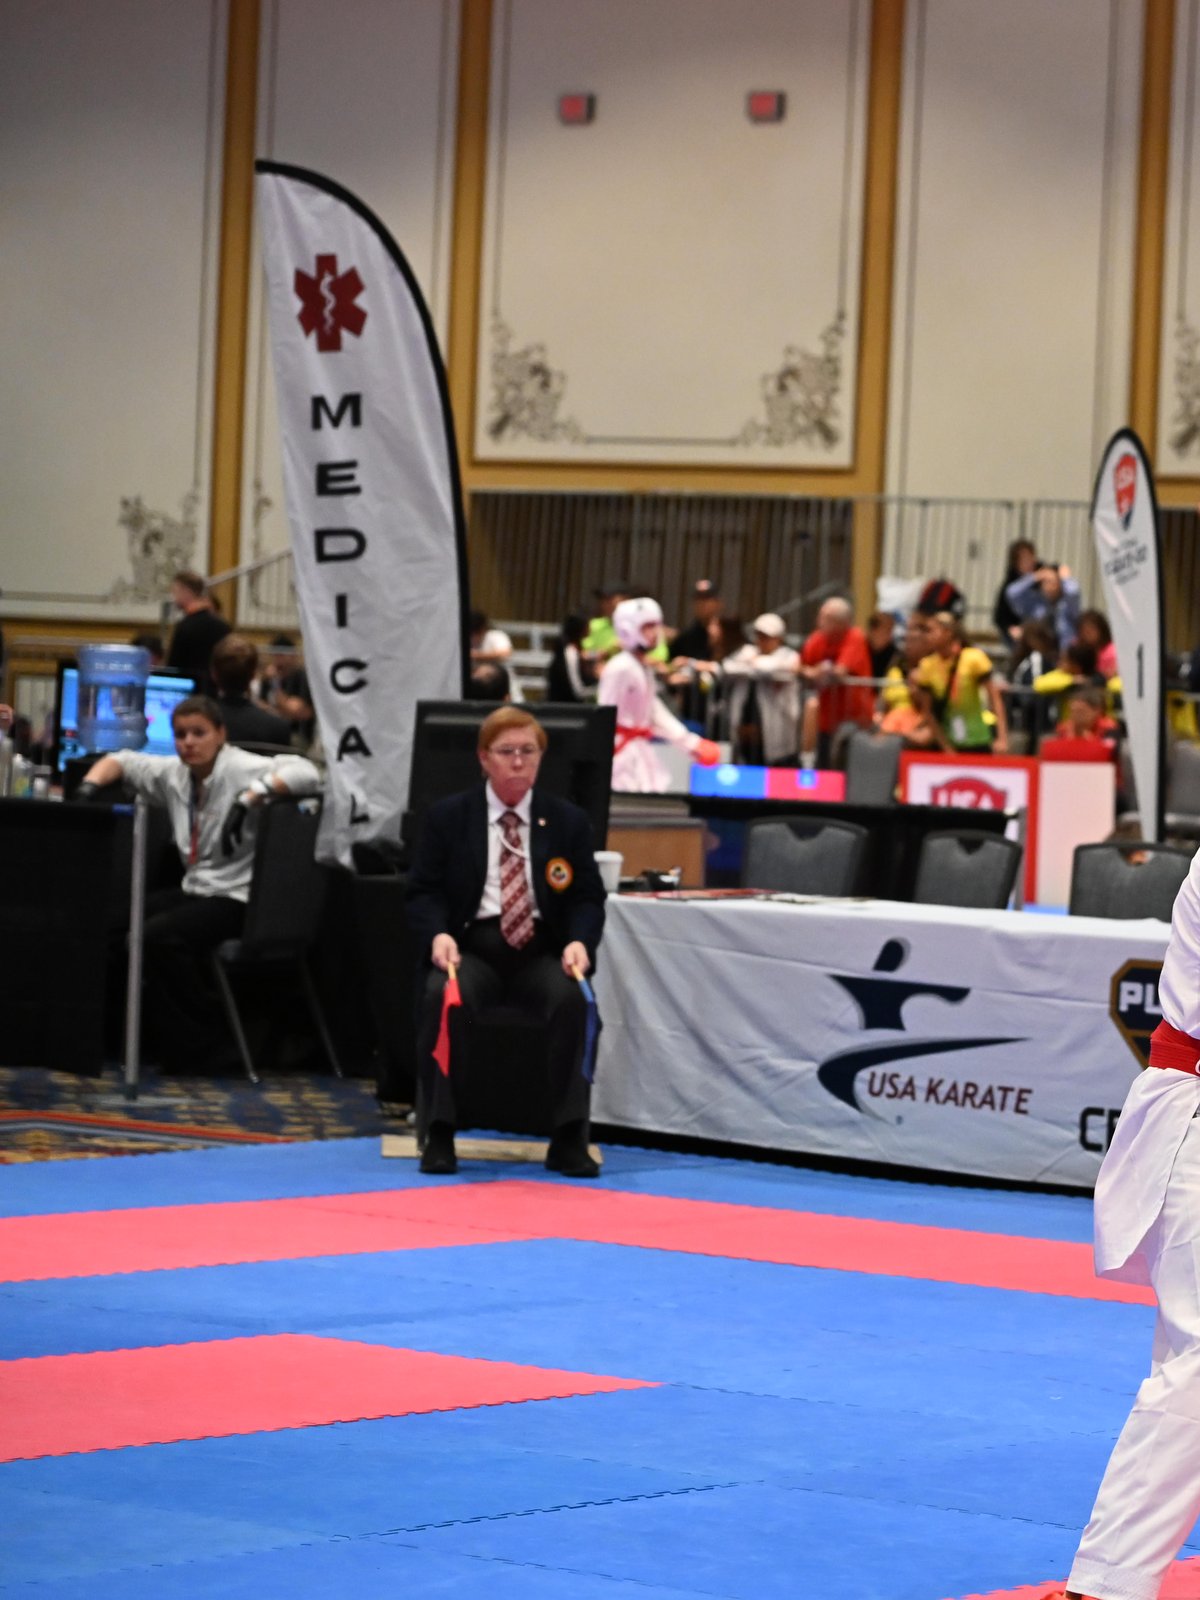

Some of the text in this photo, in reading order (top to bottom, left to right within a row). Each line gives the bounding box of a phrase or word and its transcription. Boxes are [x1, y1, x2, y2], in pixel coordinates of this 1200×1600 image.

[311, 392, 373, 825] MEDICAL
[868, 1071, 1033, 1115] USA KARATE
